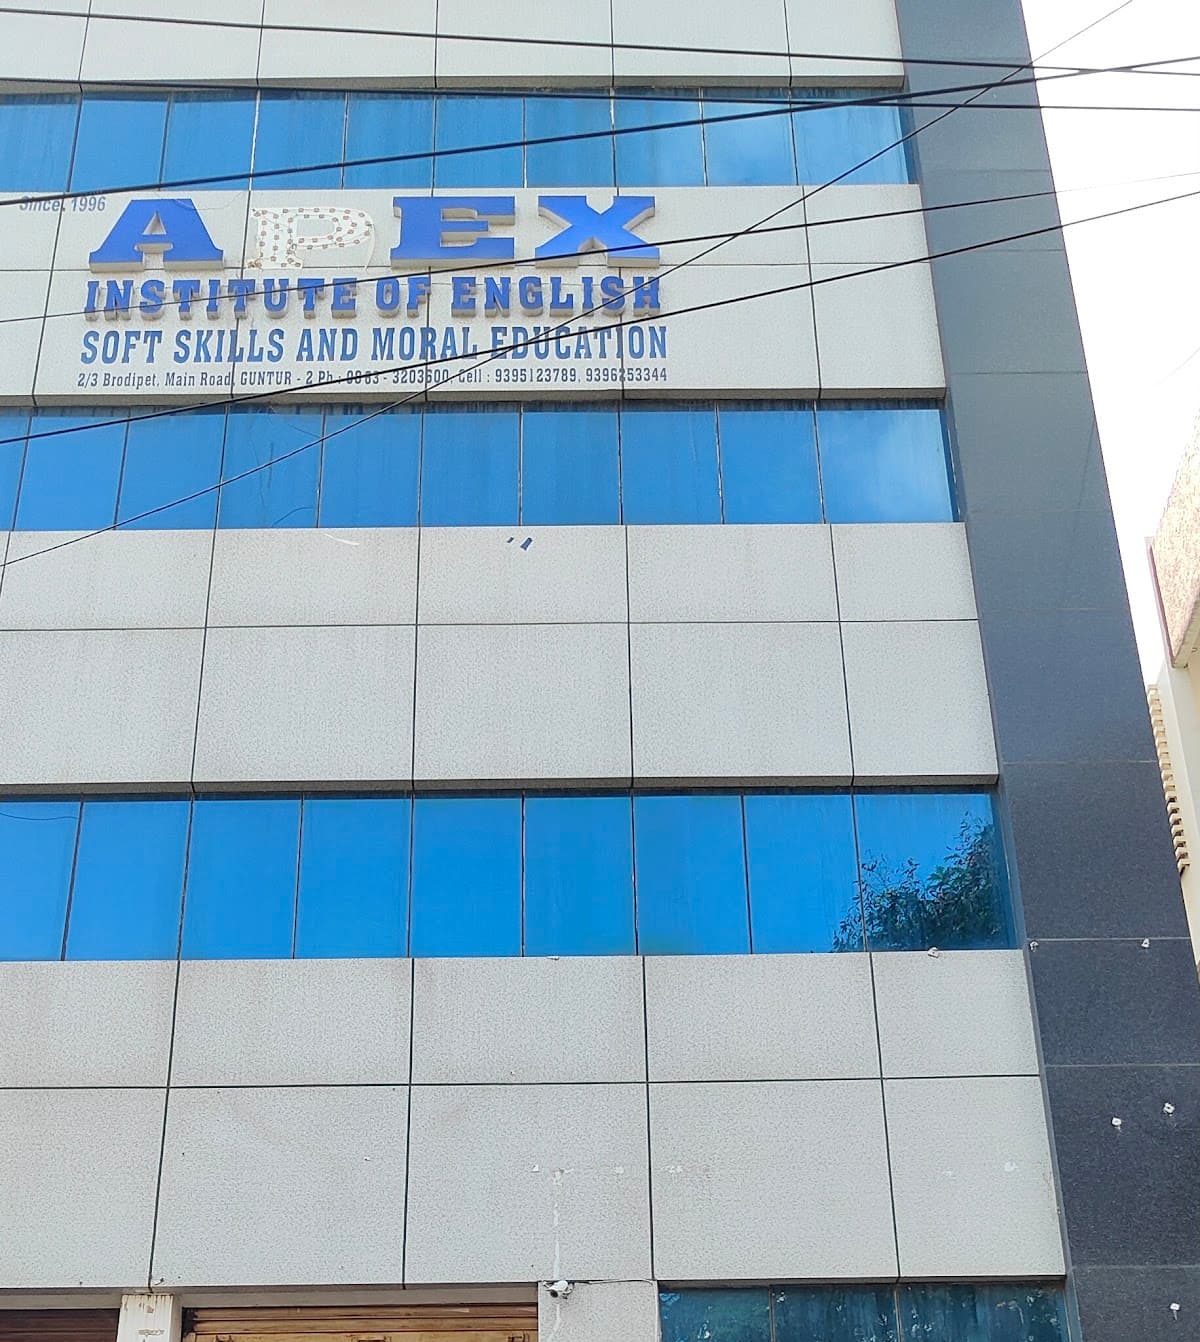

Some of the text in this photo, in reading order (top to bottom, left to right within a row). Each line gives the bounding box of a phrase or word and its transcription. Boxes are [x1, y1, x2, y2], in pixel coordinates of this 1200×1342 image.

[71, 196, 106, 212] 1996
[88, 195, 661, 273] APEX
[84, 276, 661, 321] INSTITUTE OF ENGLISH
[80, 325, 667, 365] SOFT SKILLS AND MORAL EDUCATION
[77, 372, 98, 388] 2/3
[165, 371, 195, 386] Main
[240, 371, 292, 386] GUNTUR
[305, 370, 313, 385] 2
[318, 370, 333, 384] Ph
[459, 368, 482, 383] Cell
